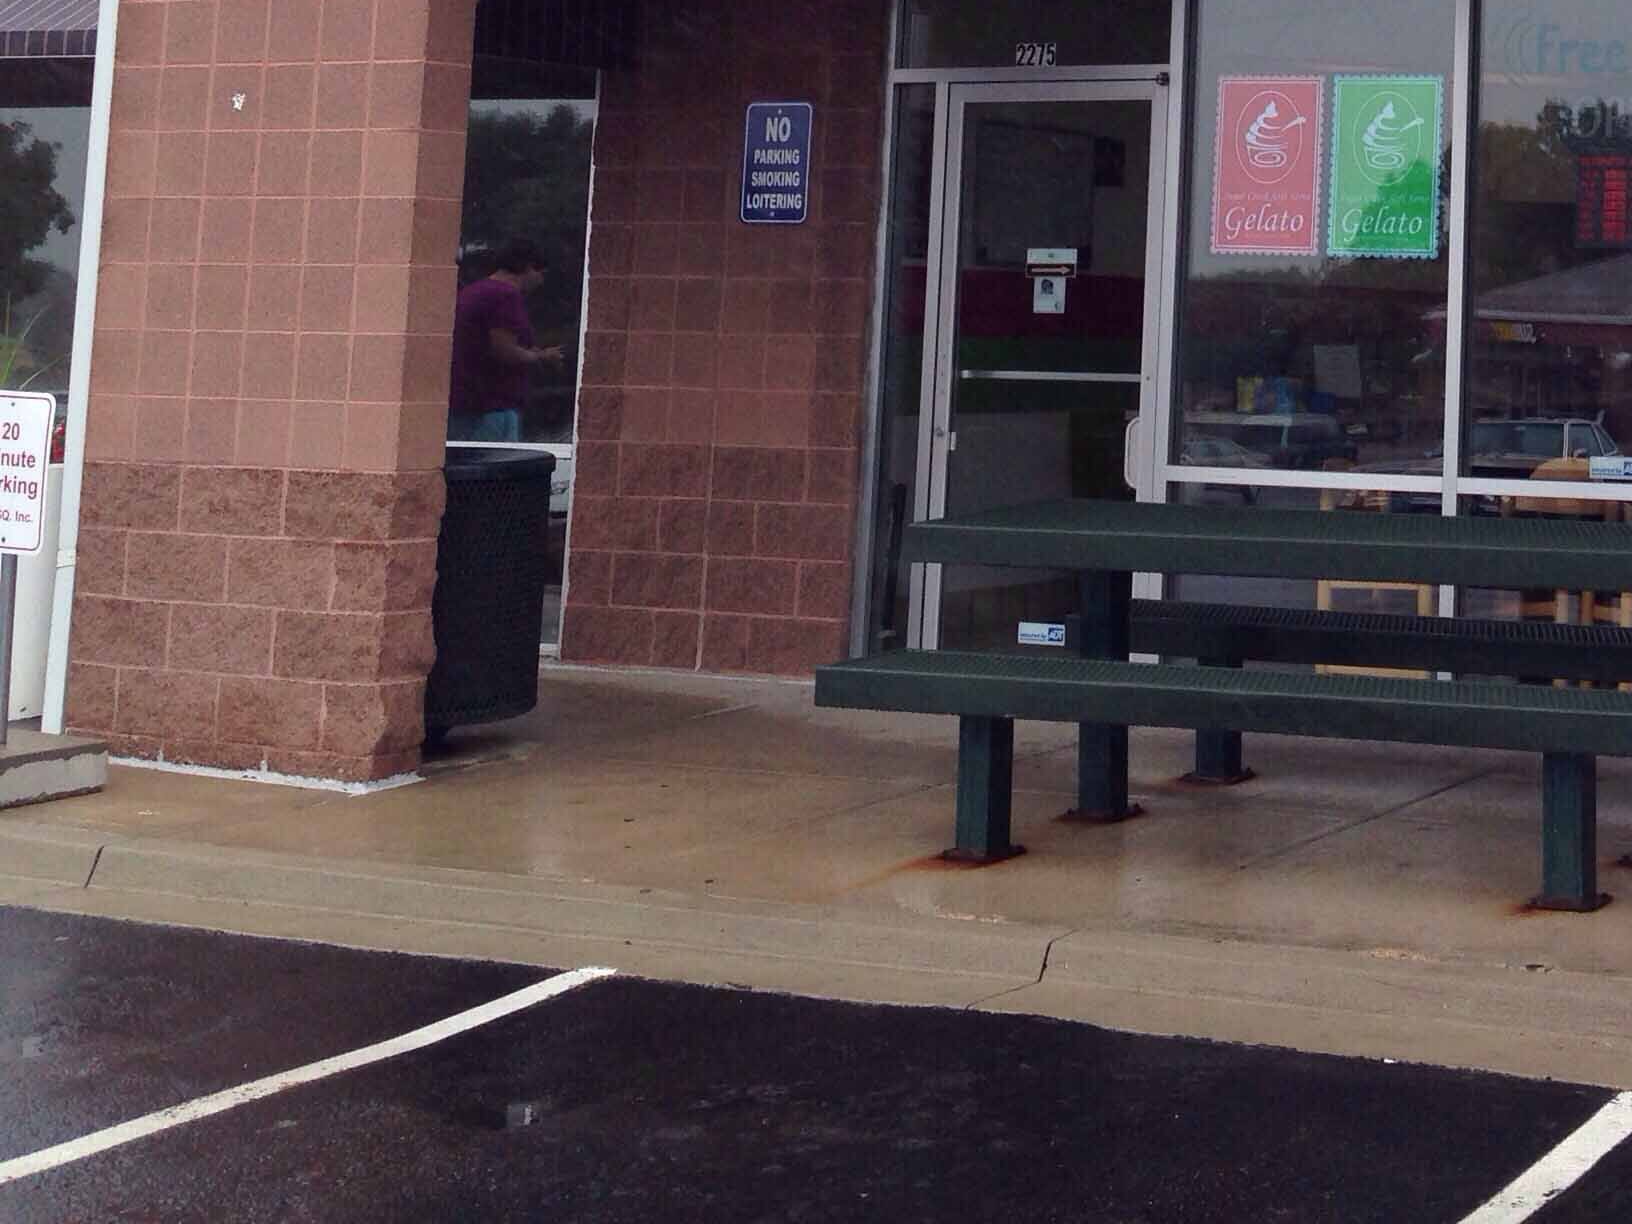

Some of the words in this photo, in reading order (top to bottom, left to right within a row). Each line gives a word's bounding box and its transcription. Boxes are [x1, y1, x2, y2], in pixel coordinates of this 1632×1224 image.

[1017, 42, 1056, 66] 2275
[765, 117, 791, 142] NO
[753, 149, 800, 164] PARKING
[751, 171, 800, 187] SMOKING
[746, 194, 802, 209] LOITERING
[1225, 203, 1304, 240] Gelato
[1342, 205, 1423, 242] Gelato
[1, 422, 20, 440] 20
